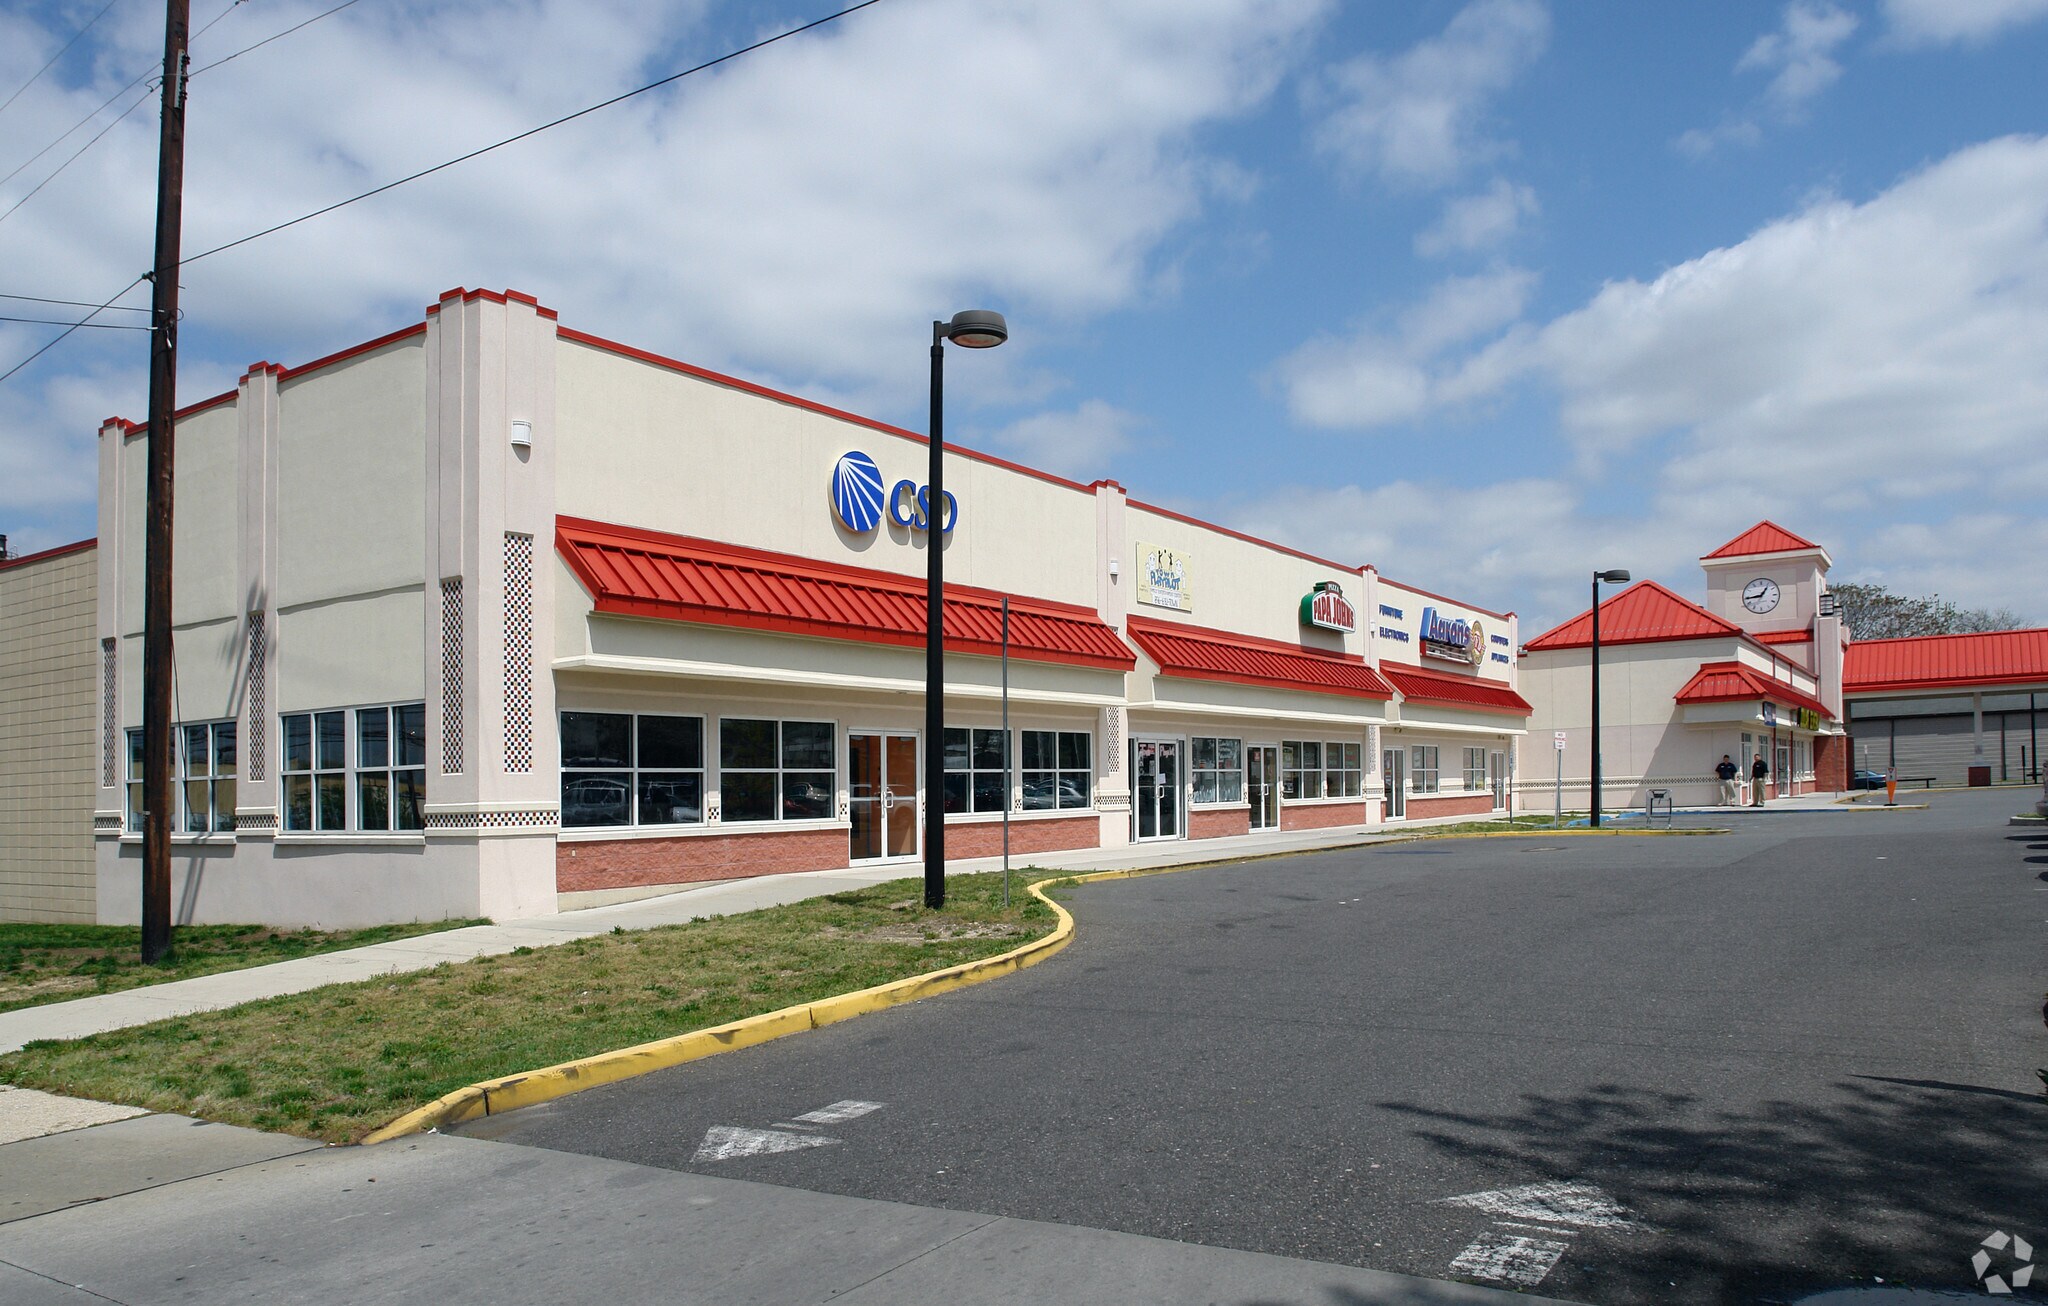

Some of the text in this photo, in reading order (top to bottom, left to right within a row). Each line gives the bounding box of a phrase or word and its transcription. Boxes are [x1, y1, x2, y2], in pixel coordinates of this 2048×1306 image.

[890, 479, 958, 533] CSD
[1328, 583, 1340, 593] PIZZA
[1314, 596, 1331, 623] PAPA
[1379, 626, 1410, 644] ELECTRONICS
[1428, 609, 1471, 645] Aaron's
